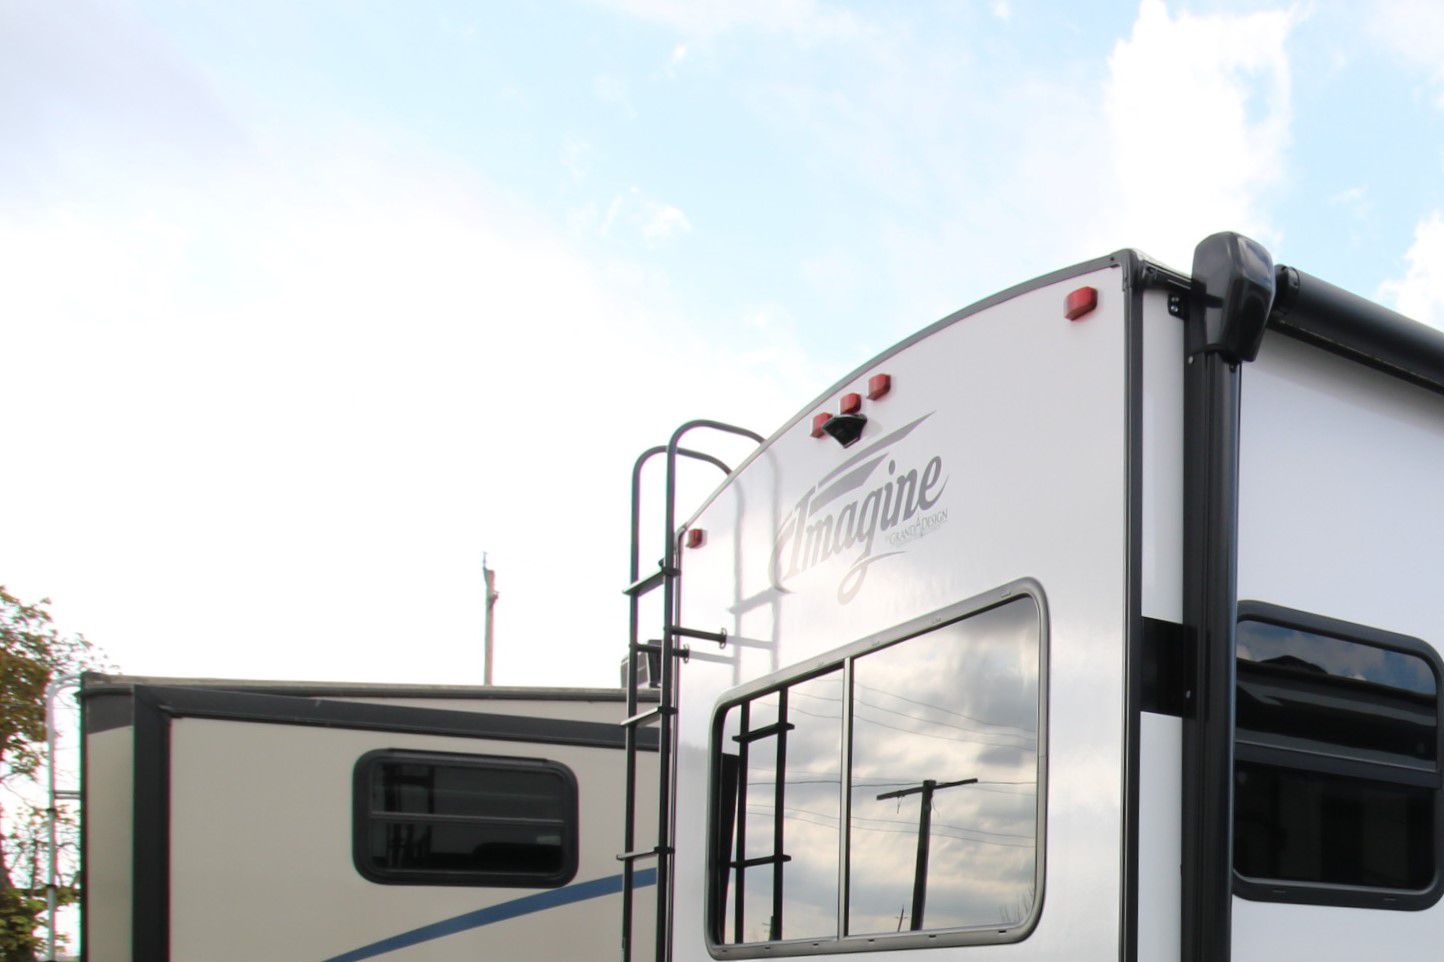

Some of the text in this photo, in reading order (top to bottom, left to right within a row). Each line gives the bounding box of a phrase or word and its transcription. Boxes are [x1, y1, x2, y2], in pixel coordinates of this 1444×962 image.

[780, 455, 950, 605] Imagine
[889, 508, 949, 545] GRAND DESIGN
